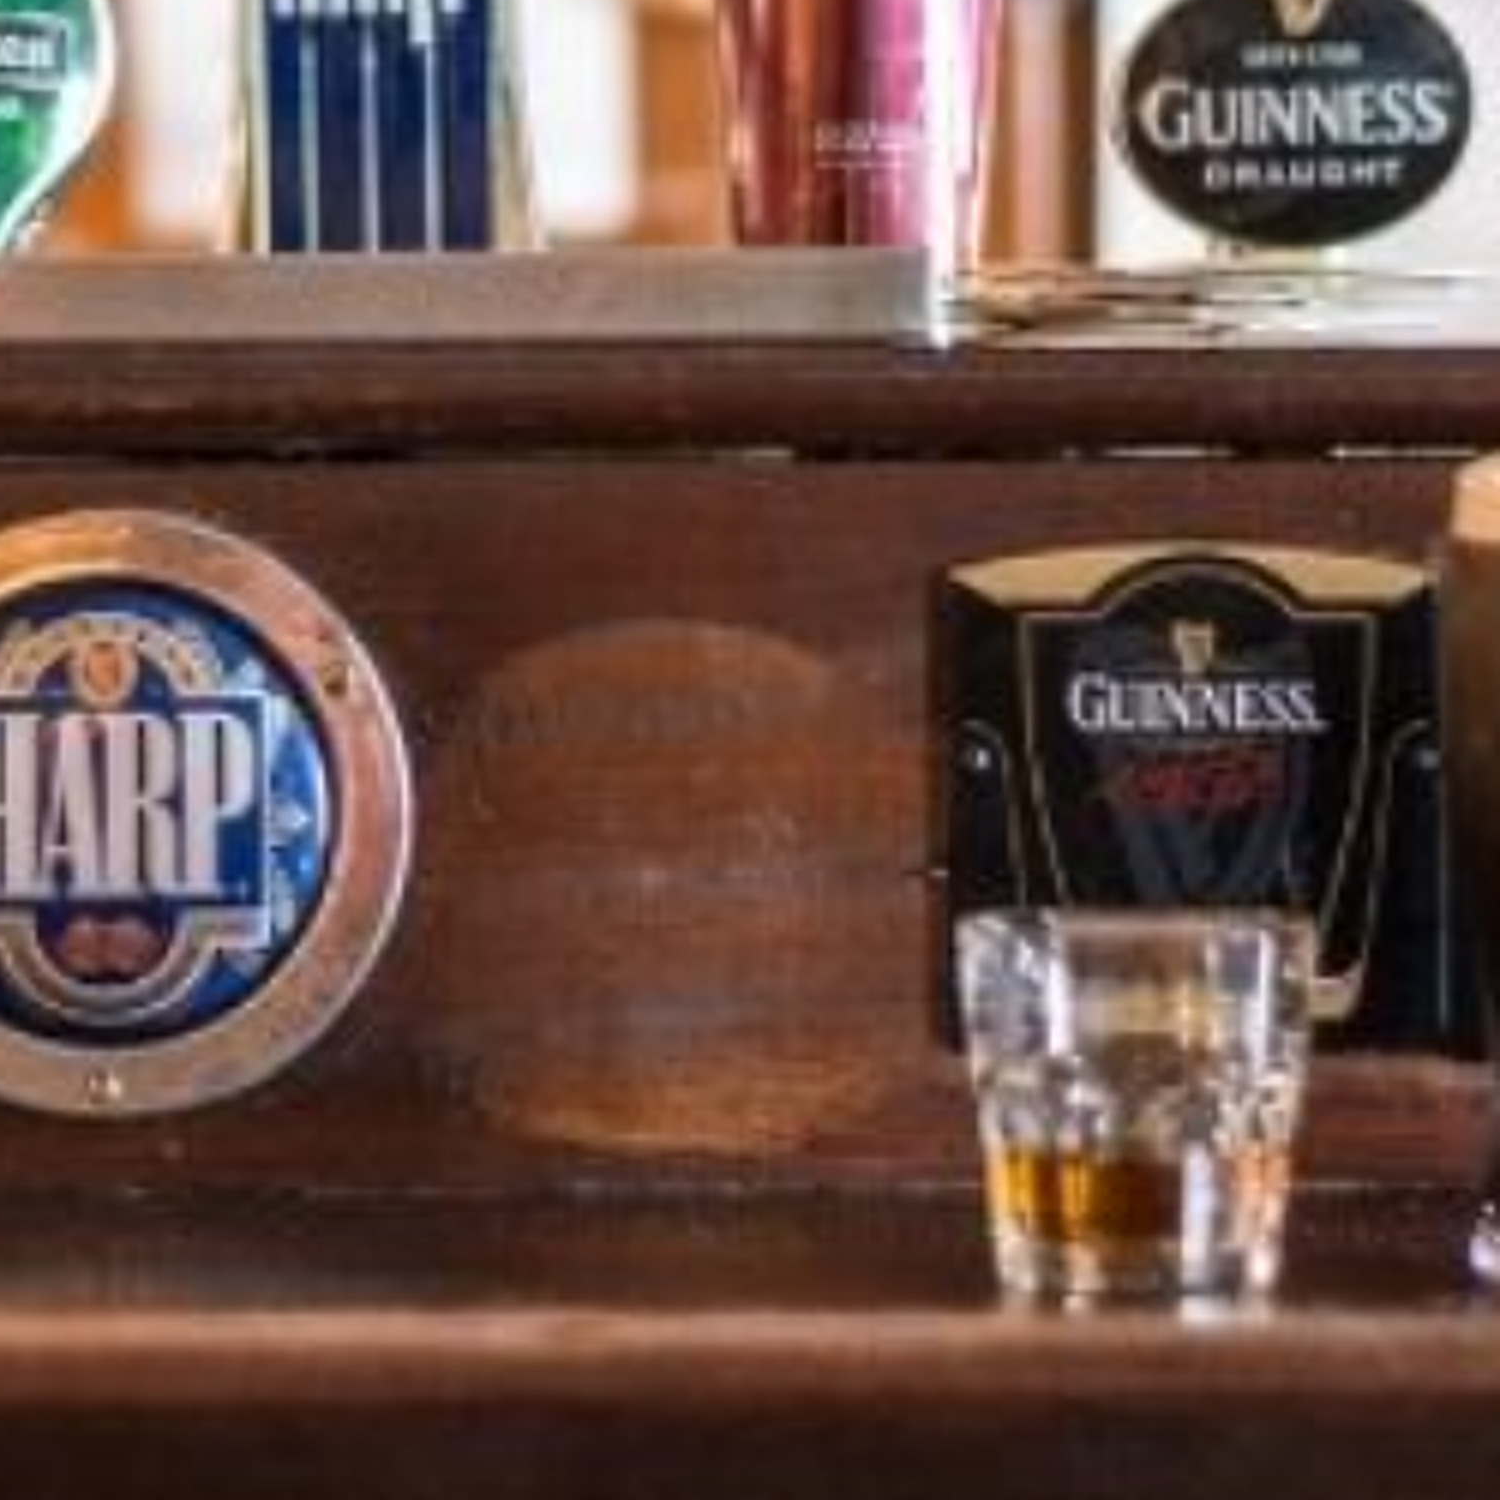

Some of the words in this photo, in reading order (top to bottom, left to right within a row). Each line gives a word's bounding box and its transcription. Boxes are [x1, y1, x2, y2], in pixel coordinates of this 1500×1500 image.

[1138, 78, 1450, 152] GUINNESS
[1203, 157, 1402, 192] DRAUGHT
[1067, 670, 1330, 734] GUINNESS
